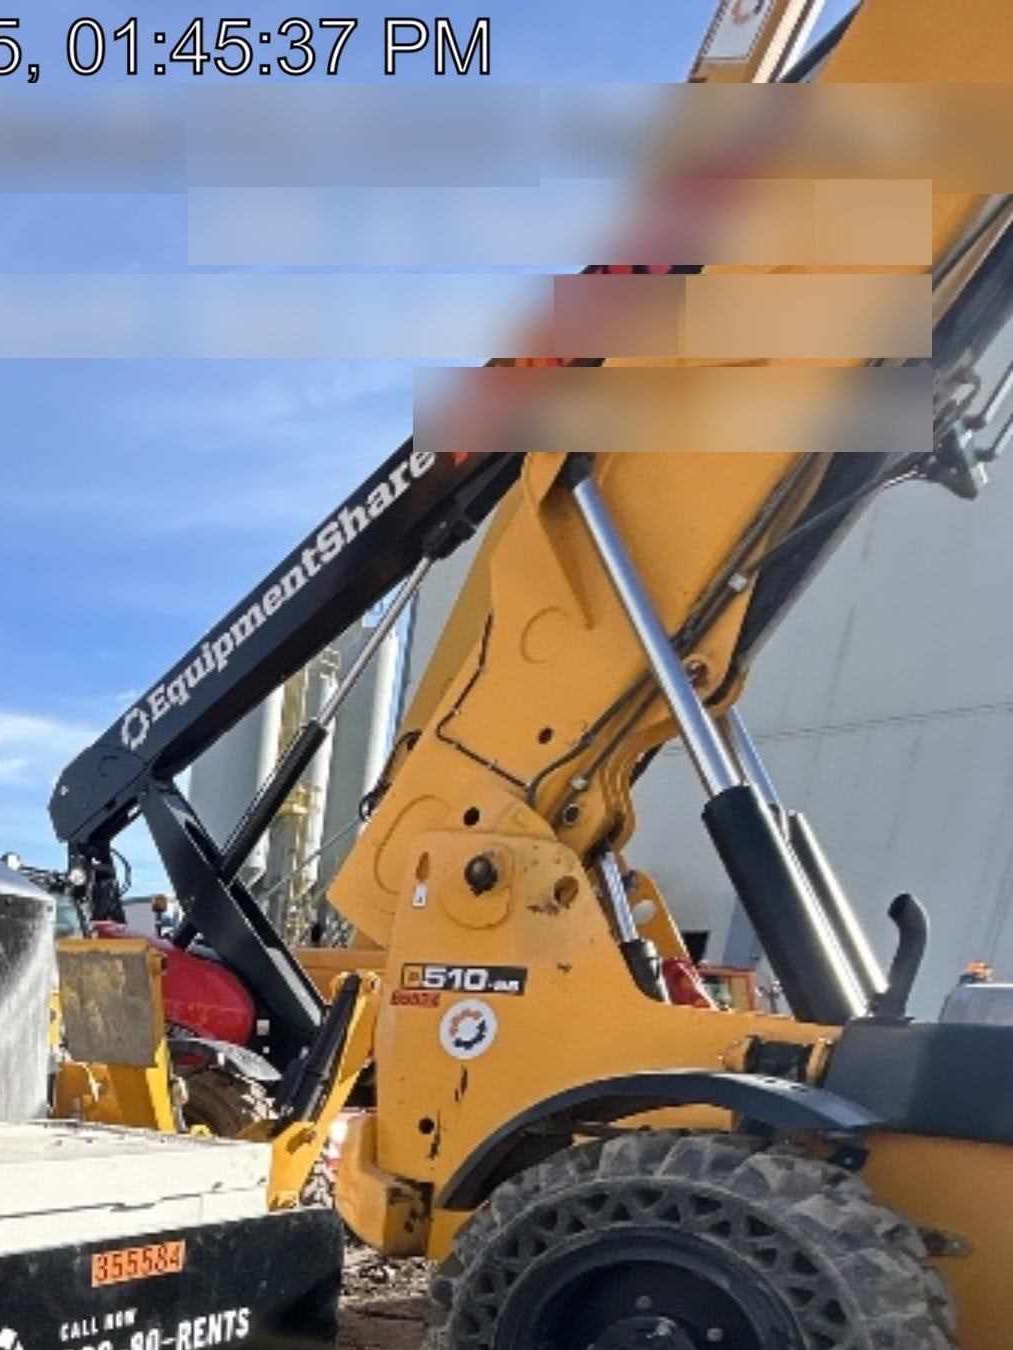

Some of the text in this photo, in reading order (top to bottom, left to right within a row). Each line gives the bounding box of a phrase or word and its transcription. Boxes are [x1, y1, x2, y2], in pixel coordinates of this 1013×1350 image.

[145, 451, 436, 724] EquipmentShare
[94, 1245, 180, 1282] 355584
[59, 1308, 138, 1342] CALL NOW
